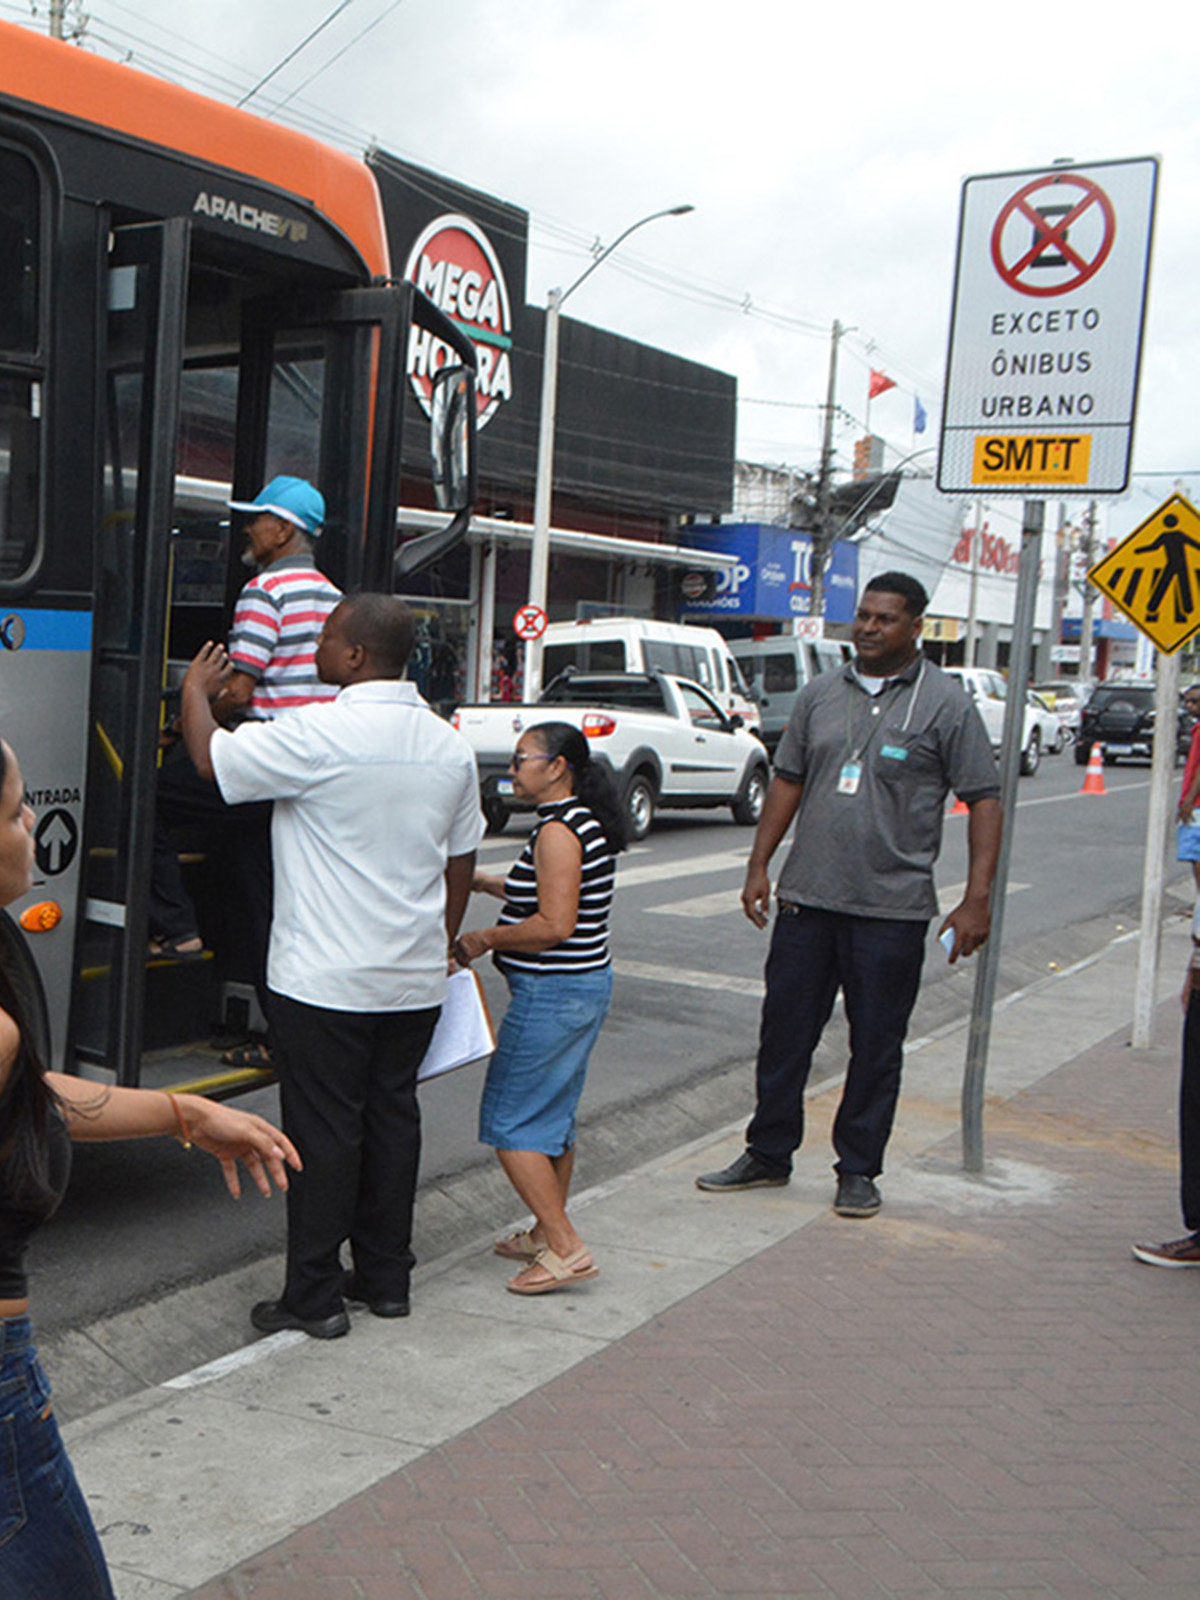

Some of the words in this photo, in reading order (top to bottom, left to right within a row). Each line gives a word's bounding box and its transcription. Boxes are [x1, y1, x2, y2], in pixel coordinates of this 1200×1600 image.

[417, 253, 500, 328] MEGA
[991, 308, 1100, 335] EXCETO
[407, 322, 512, 401] HORA
[991, 348, 1092, 377] ÔNIBUS
[981, 393, 1094, 418] URBANO
[982, 437, 1081, 471] SMTT
[25, 787, 81, 806] NTRADA
